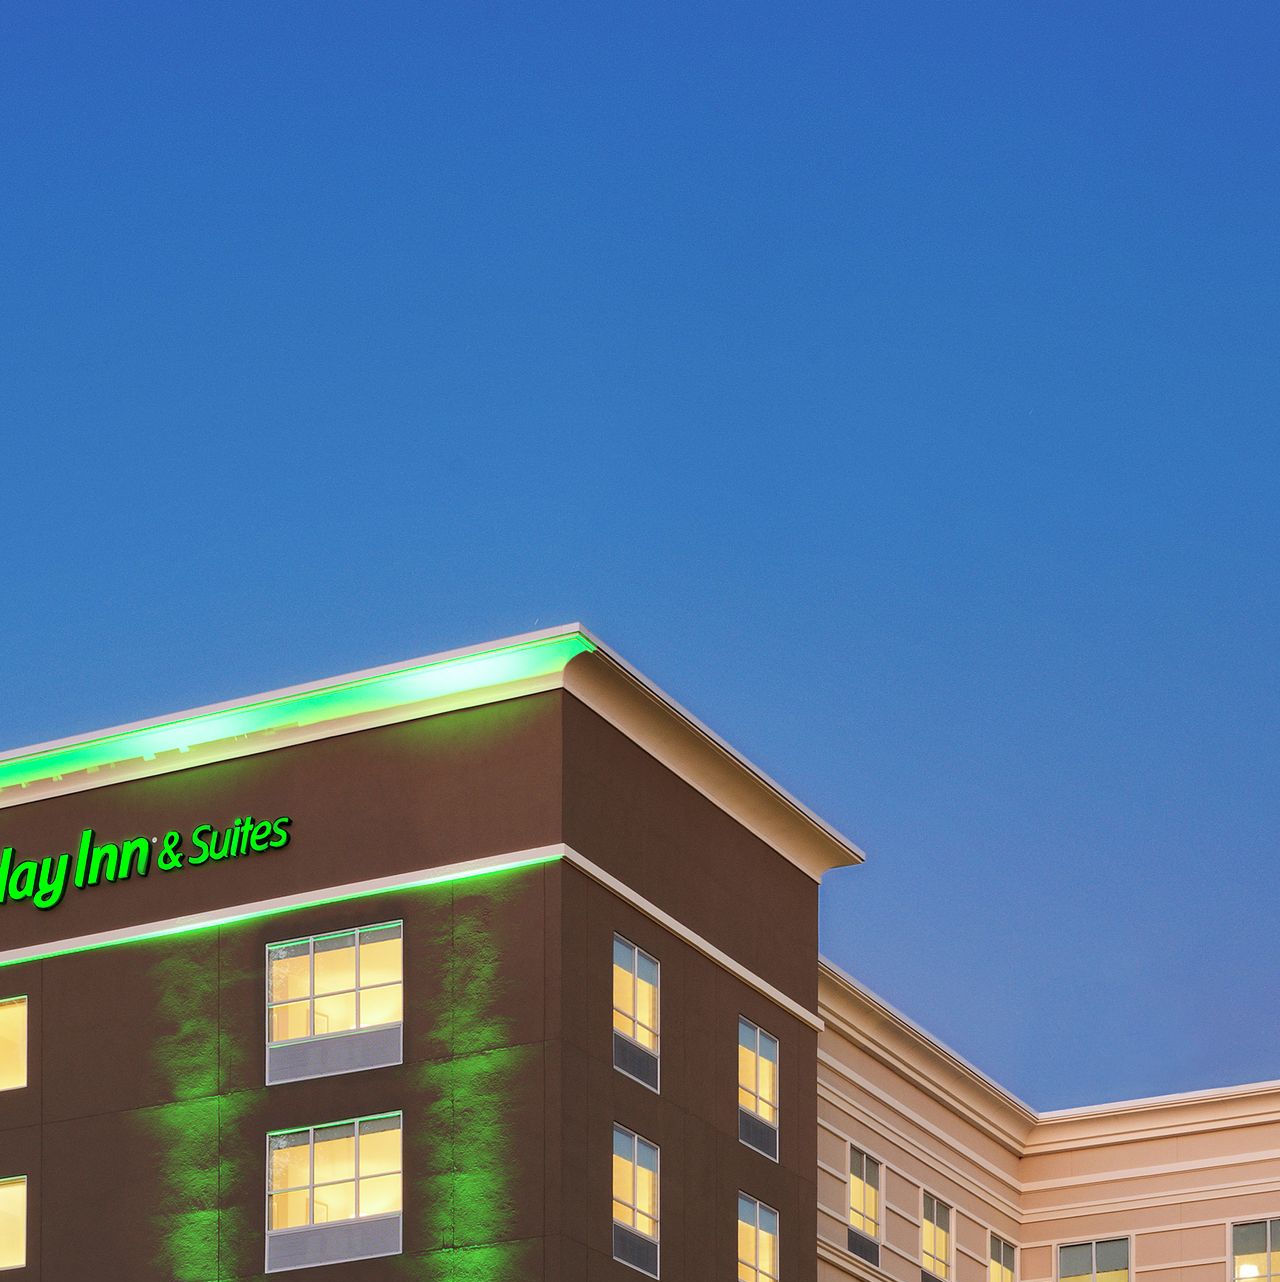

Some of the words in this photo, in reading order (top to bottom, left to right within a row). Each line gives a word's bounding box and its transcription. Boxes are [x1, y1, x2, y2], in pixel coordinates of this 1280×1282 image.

[74, 829, 152, 888] Inn
[157, 831, 185, 871] &
[188, 815, 291, 865] Suites
